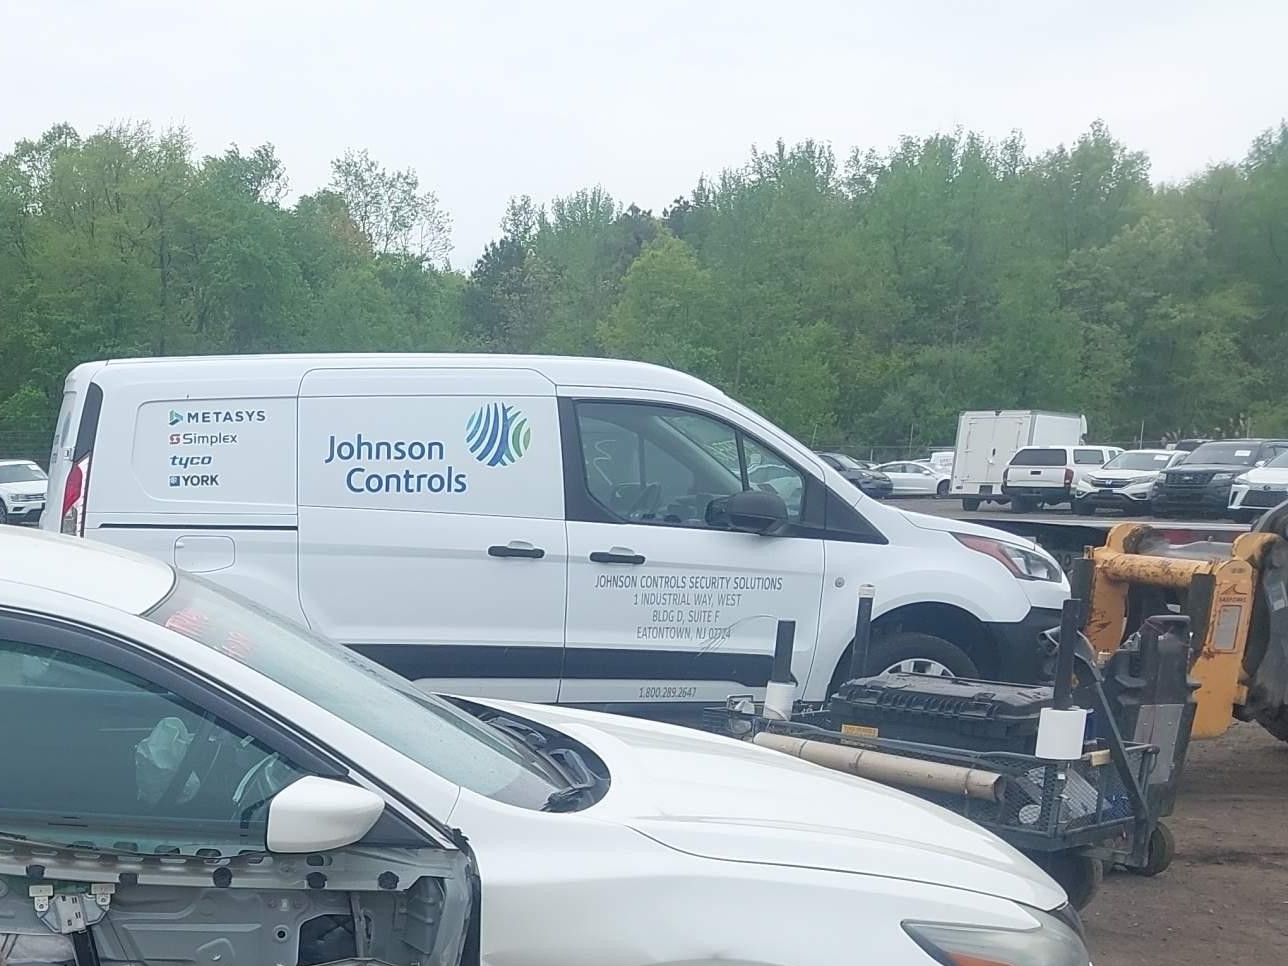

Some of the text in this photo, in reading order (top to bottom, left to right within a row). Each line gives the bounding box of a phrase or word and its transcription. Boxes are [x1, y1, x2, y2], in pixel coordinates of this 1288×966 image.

[187, 410, 266, 423] METASYS
[182, 432, 238, 446] Simplex
[324, 433, 444, 463] Johnson
[169, 455, 212, 469] tyco
[181, 474, 220, 487] YORK
[346, 466, 467, 493] Controls
[594, 575, 783, 590] JOHNSON CONTROLS SECURITY SOLUTIONS
[633, 592, 742, 608] 1 INDUSTRIAL WAY, WEST
[652, 609, 720, 625] BLDG D, SUITE F
[637, 626, 693, 640] EATONTOWN,
[695, 627, 706, 640] NJ
